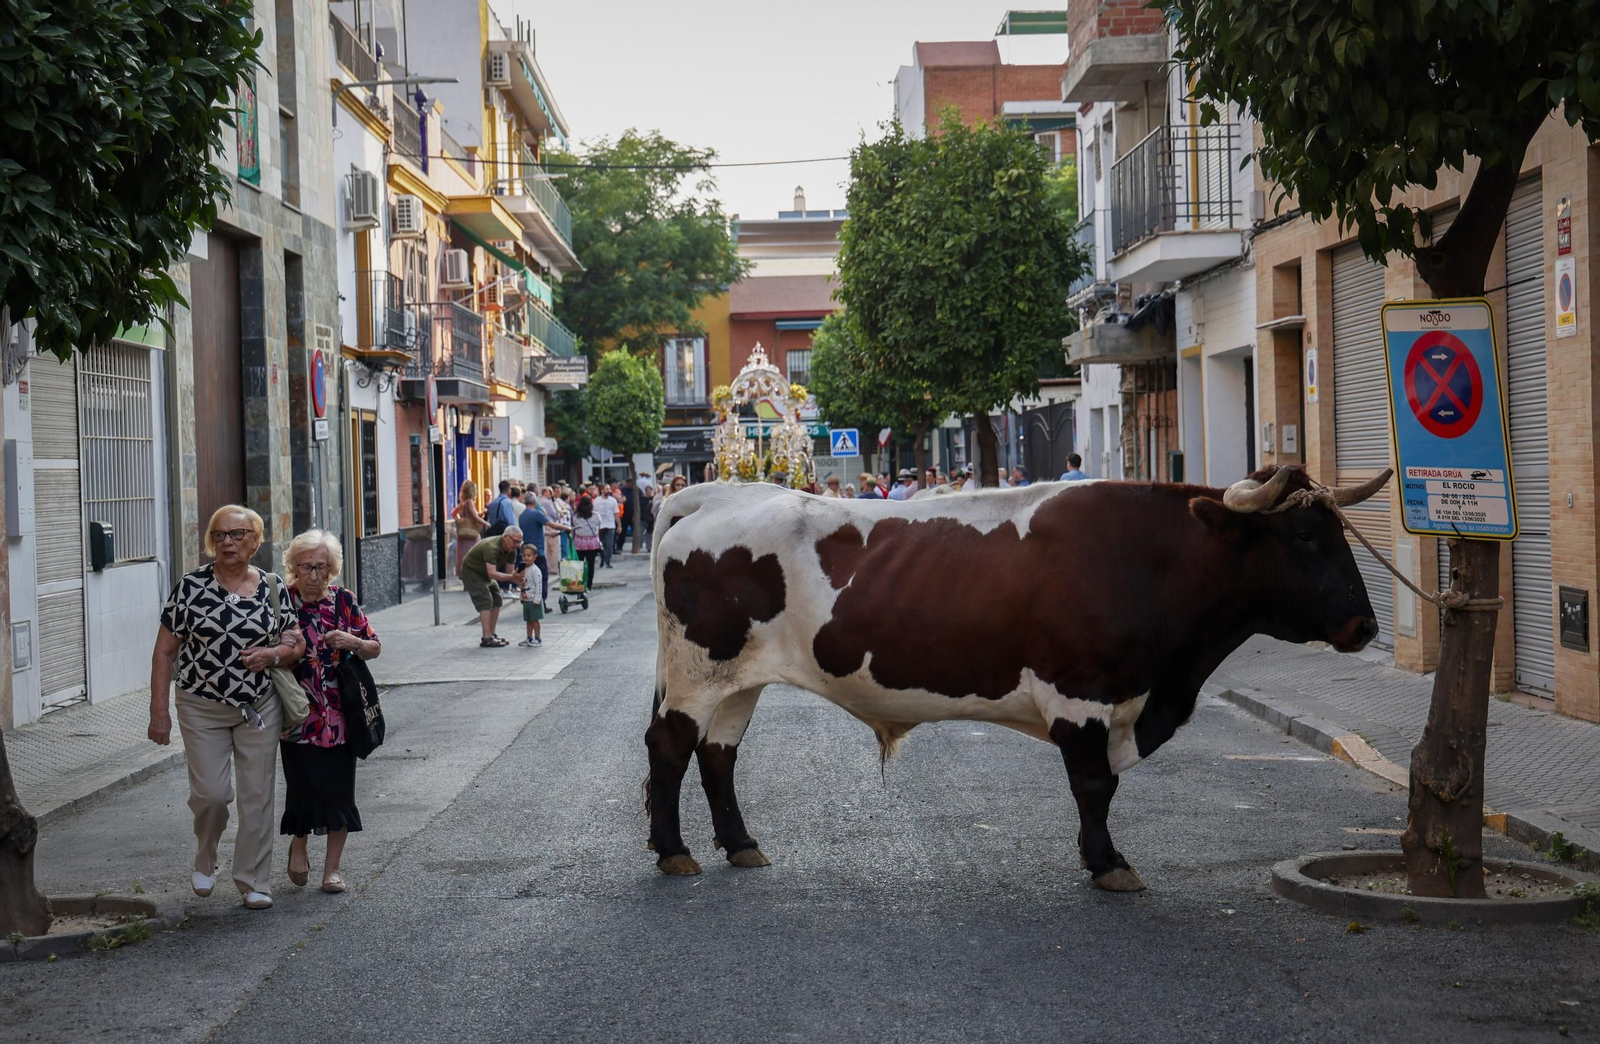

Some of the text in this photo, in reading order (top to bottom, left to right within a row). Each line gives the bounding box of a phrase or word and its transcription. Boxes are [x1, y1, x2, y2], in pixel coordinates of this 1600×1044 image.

[1408, 469, 1463, 479] RETIRADA GRÚA
[1475, 524, 1509, 533] colaboración
